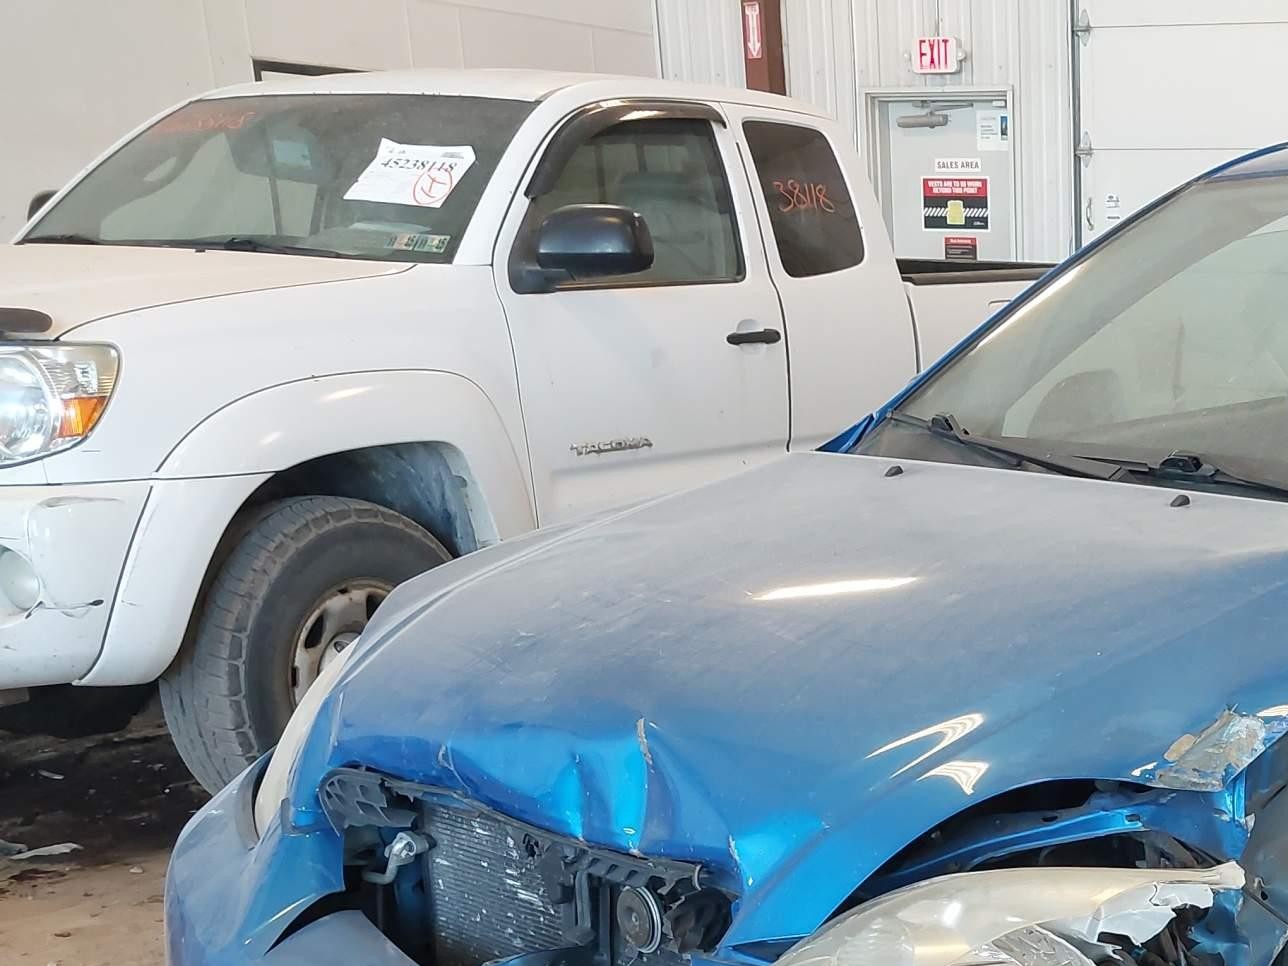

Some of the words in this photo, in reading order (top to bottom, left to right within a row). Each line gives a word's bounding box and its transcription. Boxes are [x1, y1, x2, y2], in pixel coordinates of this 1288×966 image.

[918, 38, 949, 70] EXIT
[937, 161, 959, 169] SALES
[960, 161, 980, 169] AREA
[773, 179, 836, 213] 38118
